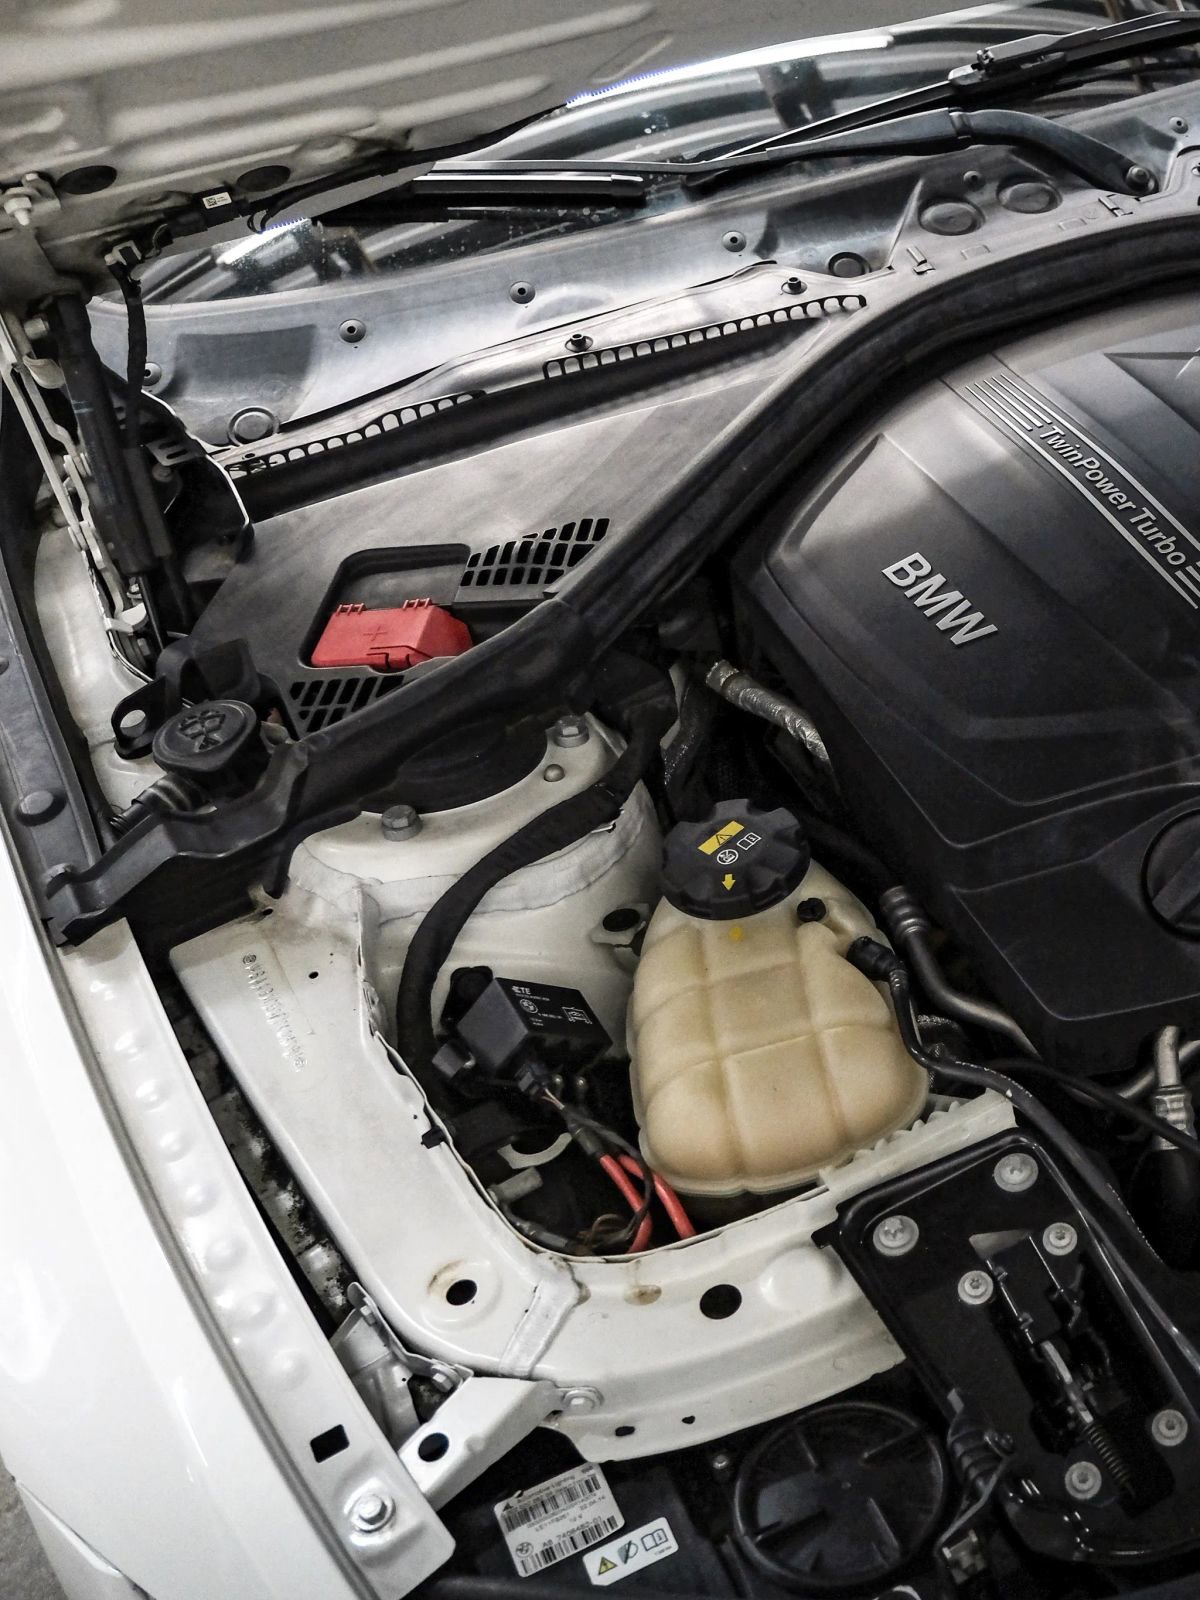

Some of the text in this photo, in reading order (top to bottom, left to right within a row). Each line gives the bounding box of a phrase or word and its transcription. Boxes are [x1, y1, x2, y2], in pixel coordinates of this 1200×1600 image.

[1040, 426, 1186, 566] TwinPower Turbo
[881, 552, 998, 646] BMW
